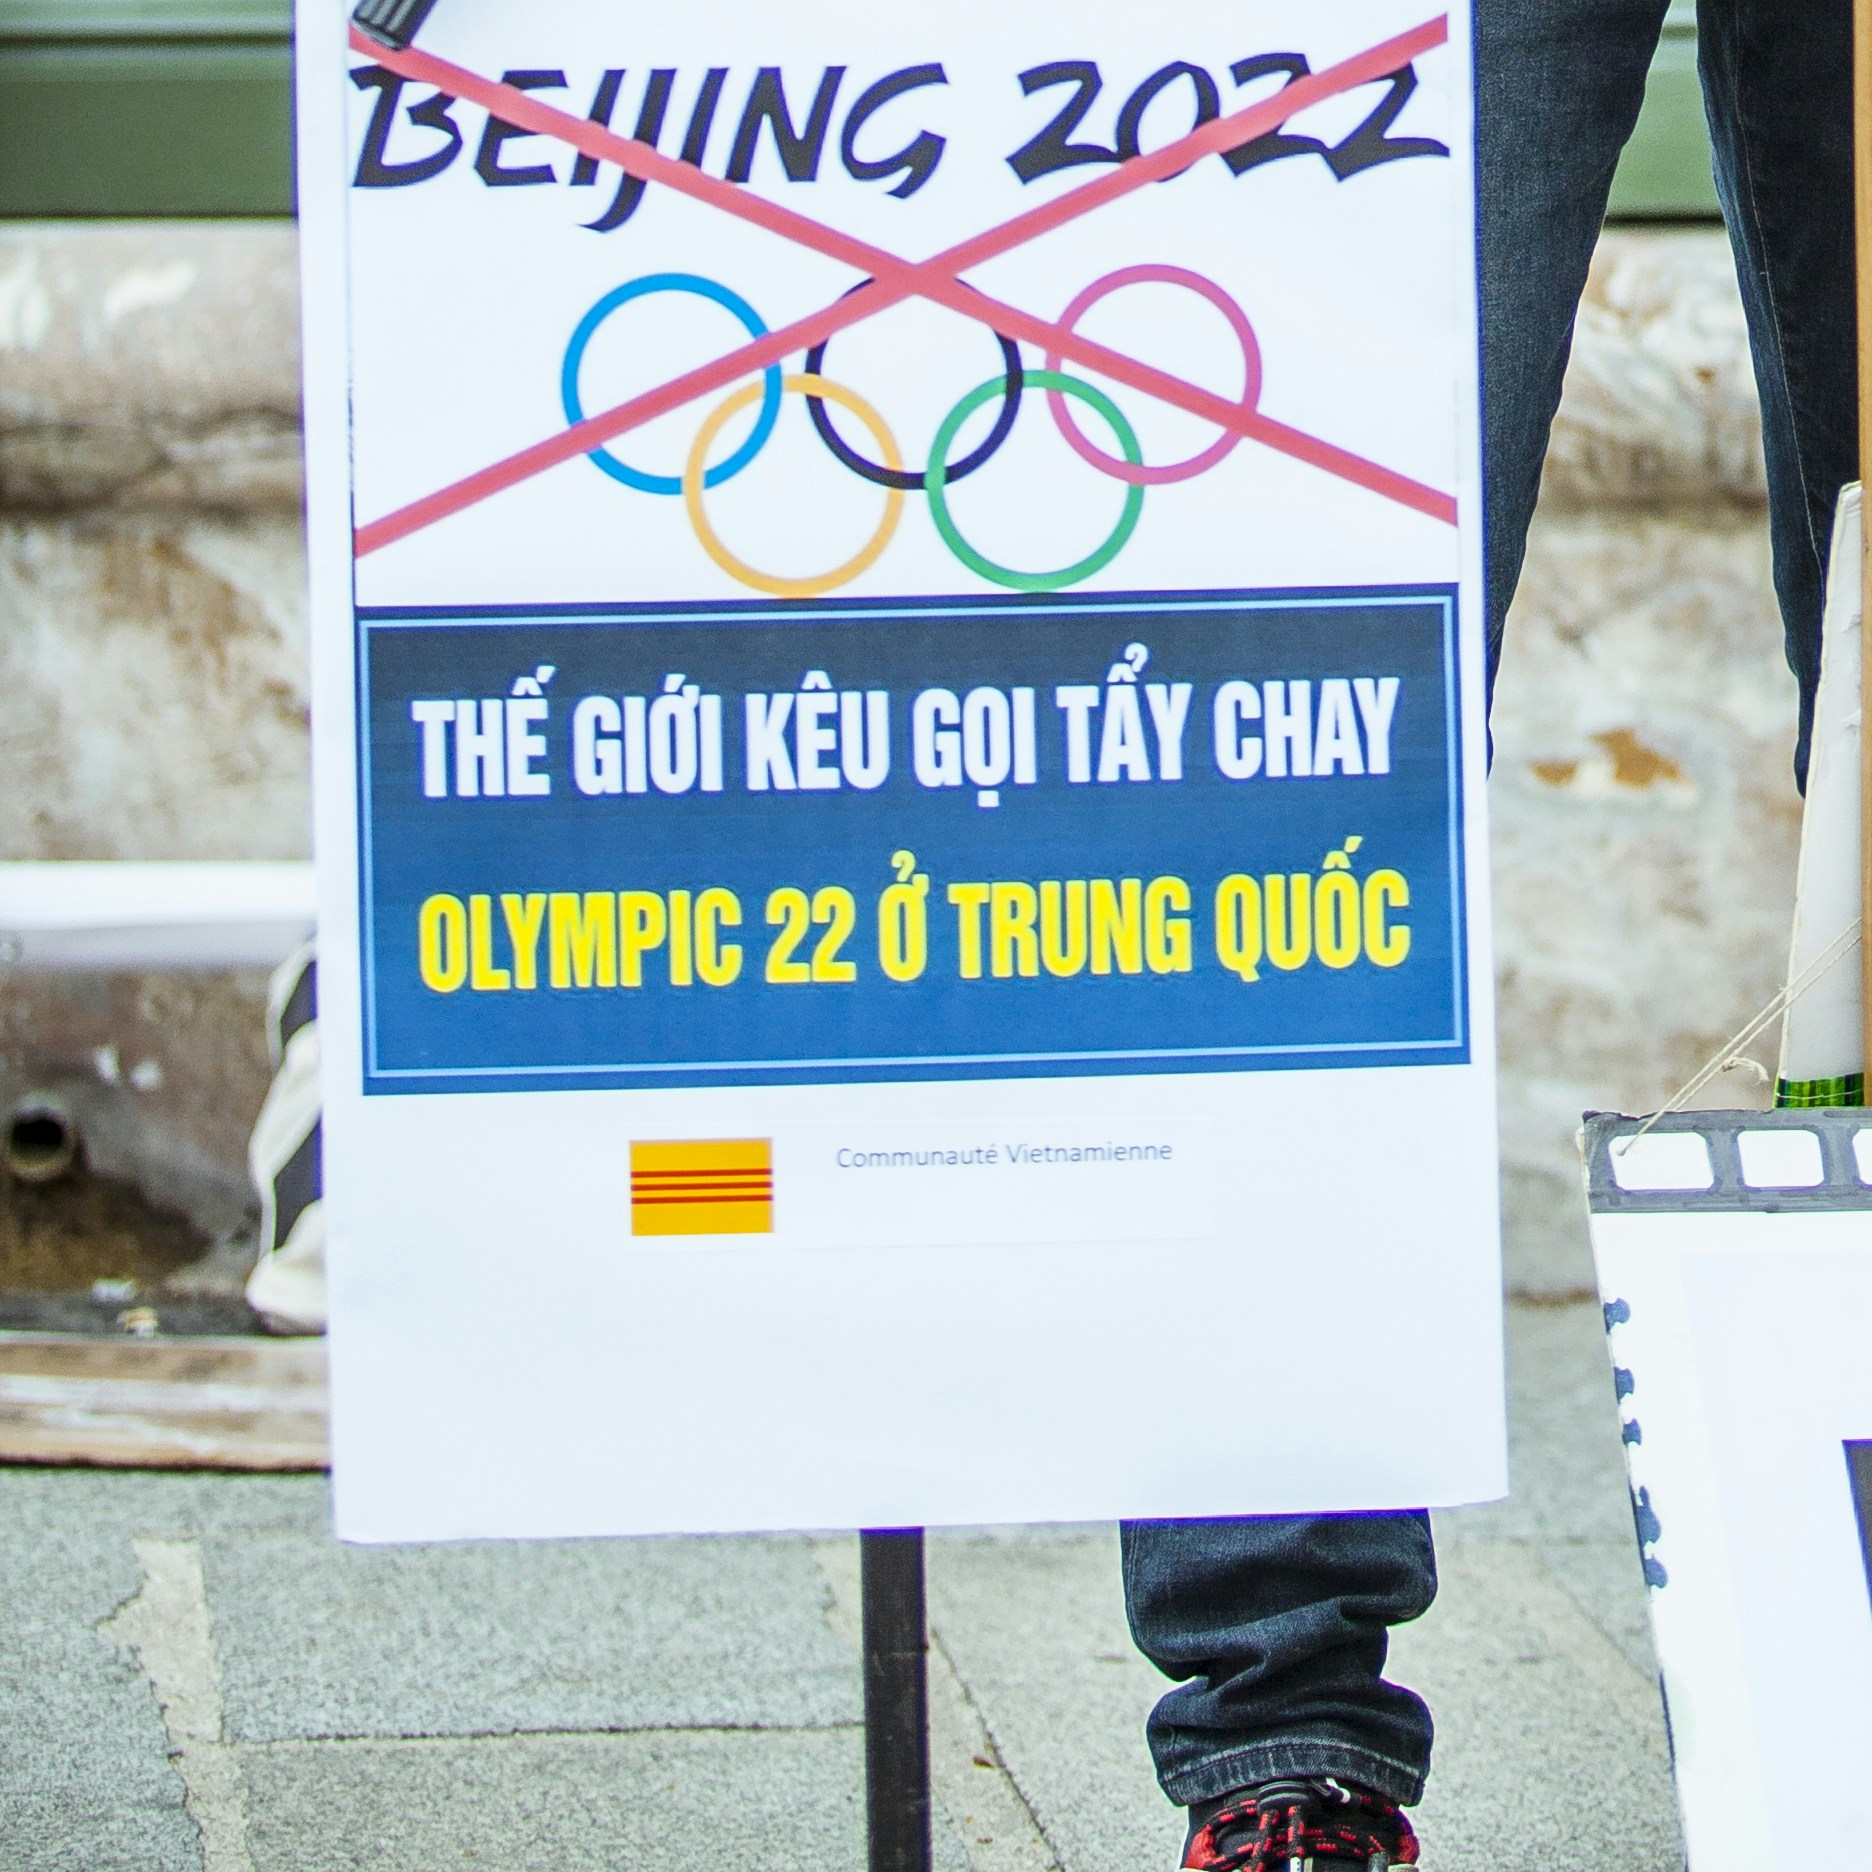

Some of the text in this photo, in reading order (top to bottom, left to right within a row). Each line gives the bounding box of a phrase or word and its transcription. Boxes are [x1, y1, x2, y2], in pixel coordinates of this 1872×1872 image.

[346, 51, 1450, 233] BEIJING 2022
[410, 642, 1400, 809] THẾ GIỚI KÊU GỌI TẨY CHAY
[417, 835, 1412, 993] OLYMPIC 22 Ở TRUNG QUỐC
[836, 1141, 1173, 1168] Communauté Vietnamienne
